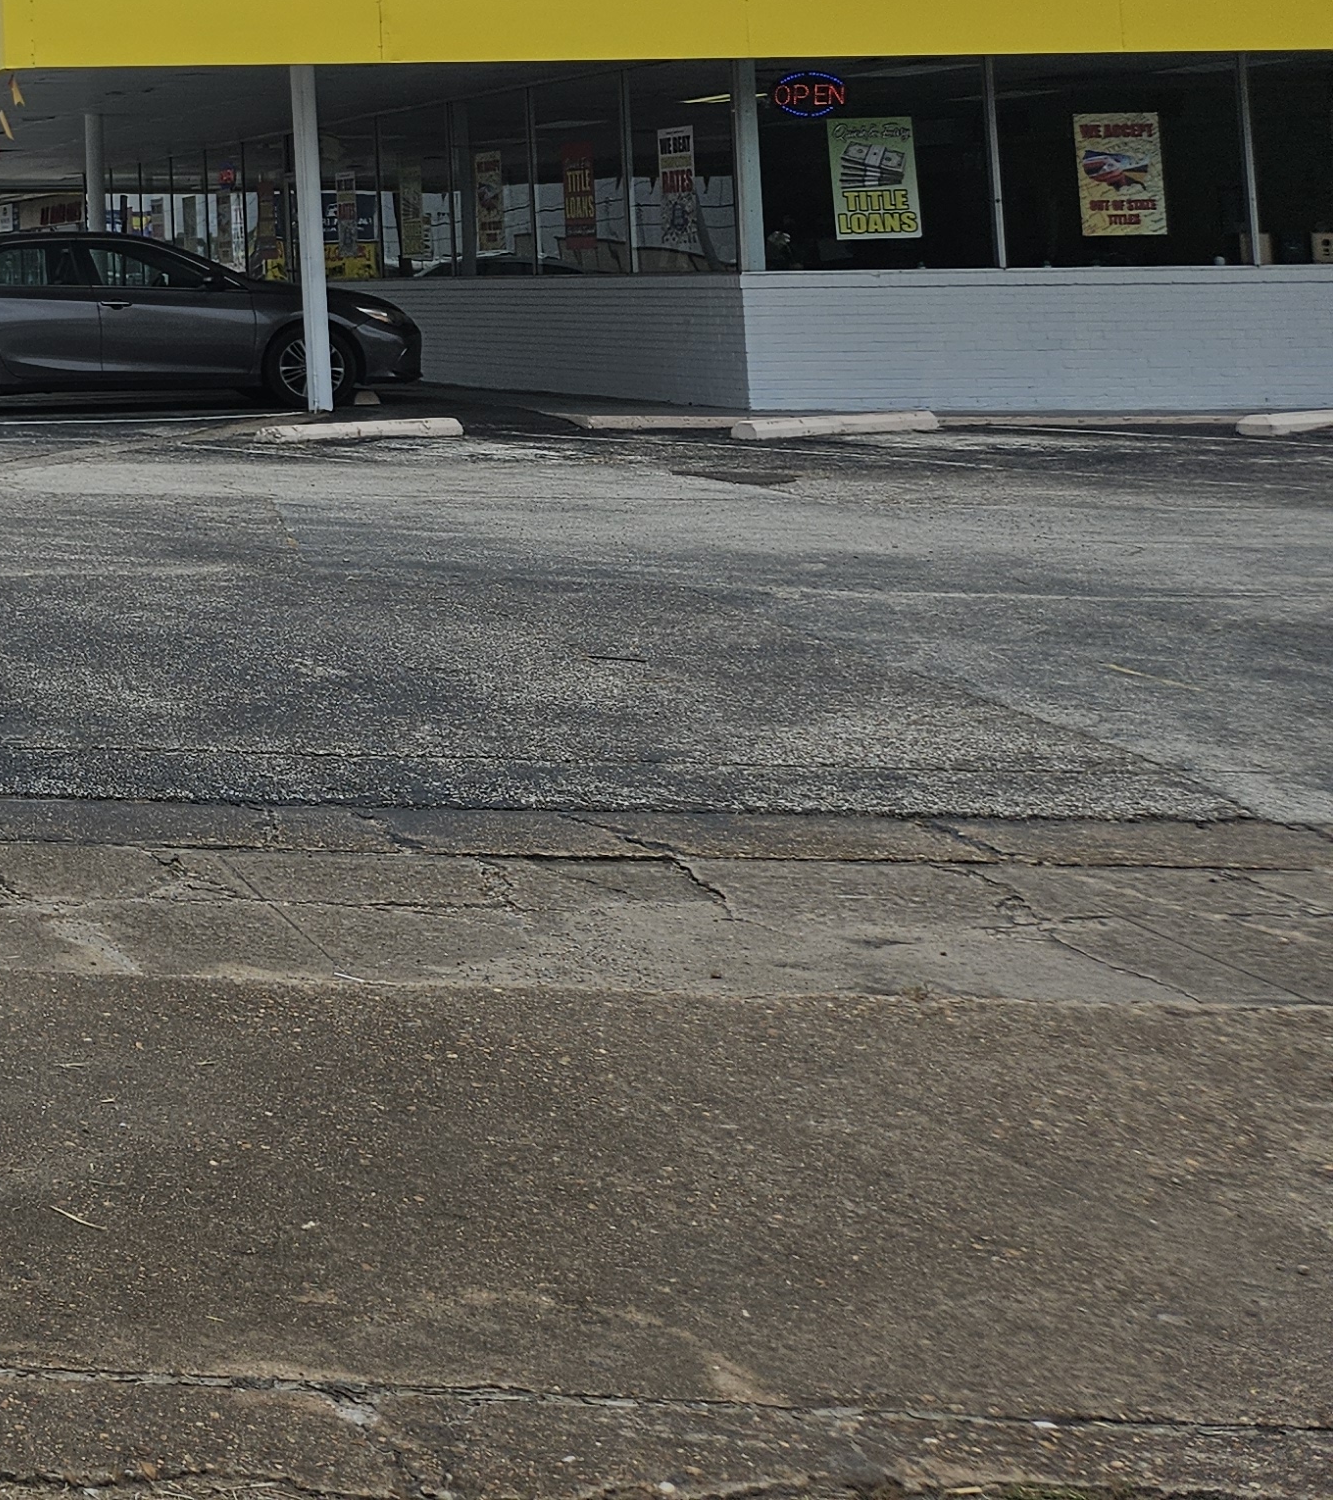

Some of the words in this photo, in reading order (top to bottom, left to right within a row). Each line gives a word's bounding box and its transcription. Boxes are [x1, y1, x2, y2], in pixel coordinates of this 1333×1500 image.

[774, 84, 847, 106] OPEN
[567, 169, 590, 192] TITLE
[661, 170, 693, 194] RATES
[565, 195, 594, 219] LOANS
[842, 189, 910, 212] TITLE
[838, 211, 918, 234] LOANS
